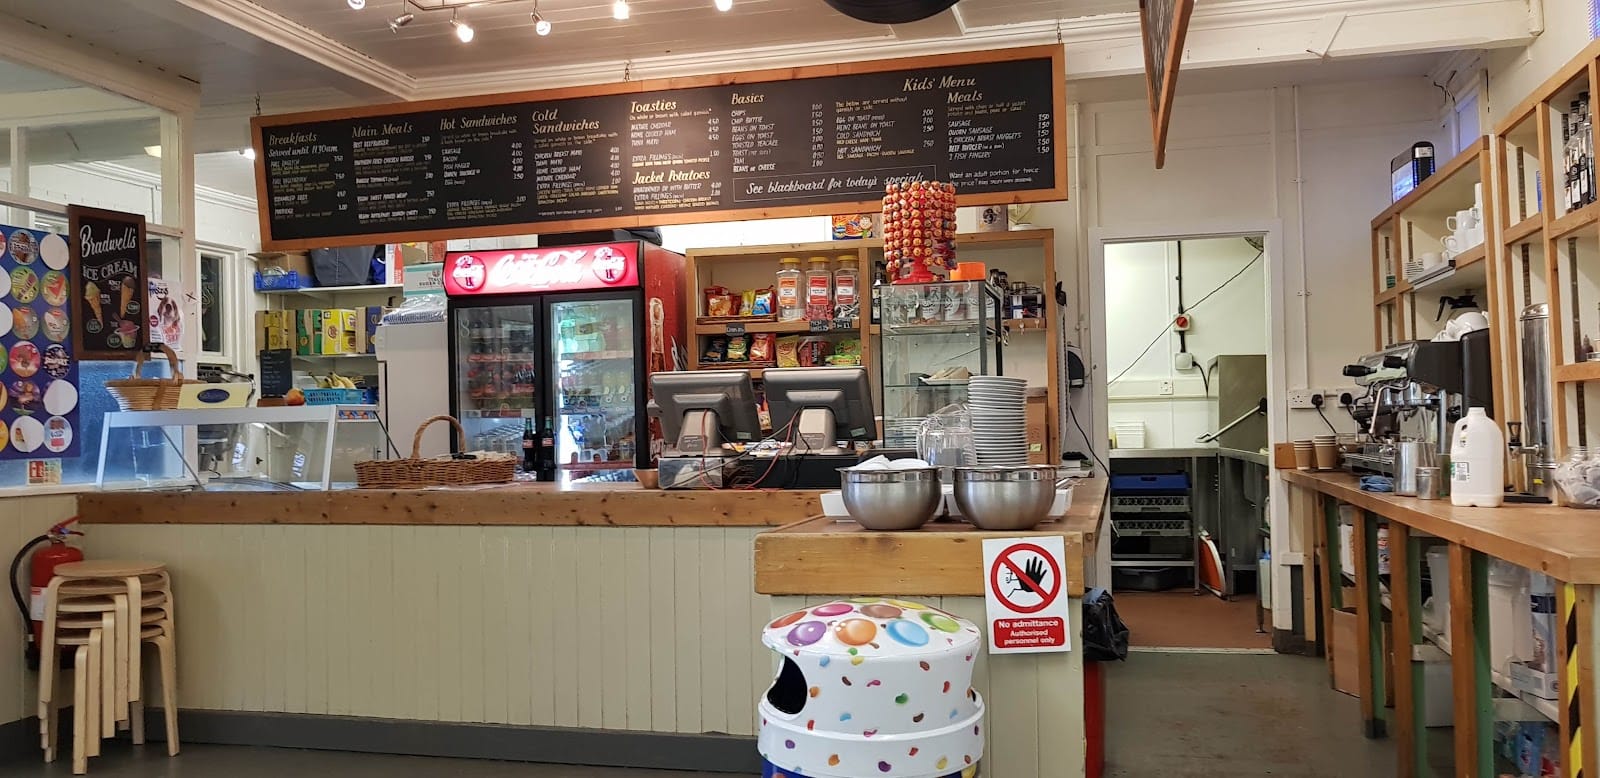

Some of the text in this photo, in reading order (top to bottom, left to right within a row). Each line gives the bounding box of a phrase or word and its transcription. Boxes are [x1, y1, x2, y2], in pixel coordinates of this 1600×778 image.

[903, 75, 977, 91] Kids' Menu
[731, 93, 764, 105] Basics
[947, 90, 983, 103] Meals
[631, 99, 676, 113] Toasties
[440, 113, 518, 130] Hot Sandwiches
[532, 108, 558, 122] Cold
[352, 122, 413, 138] Main Meals
[532, 119, 600, 135] Sandwiches
[269, 132, 317, 146] Breakfasts
[632, 169, 711, 185] Jacket Potatoes
[746, 171, 924, 195] See blackboard for today's specials
[80, 224, 137, 258] Bradwell's
[82, 260, 138, 281] ICE CREAM
[998, 619, 1059, 629] No admittance
[1010, 629, 1049, 637] Authorised
[1003, 636, 1056, 646] personnel only
